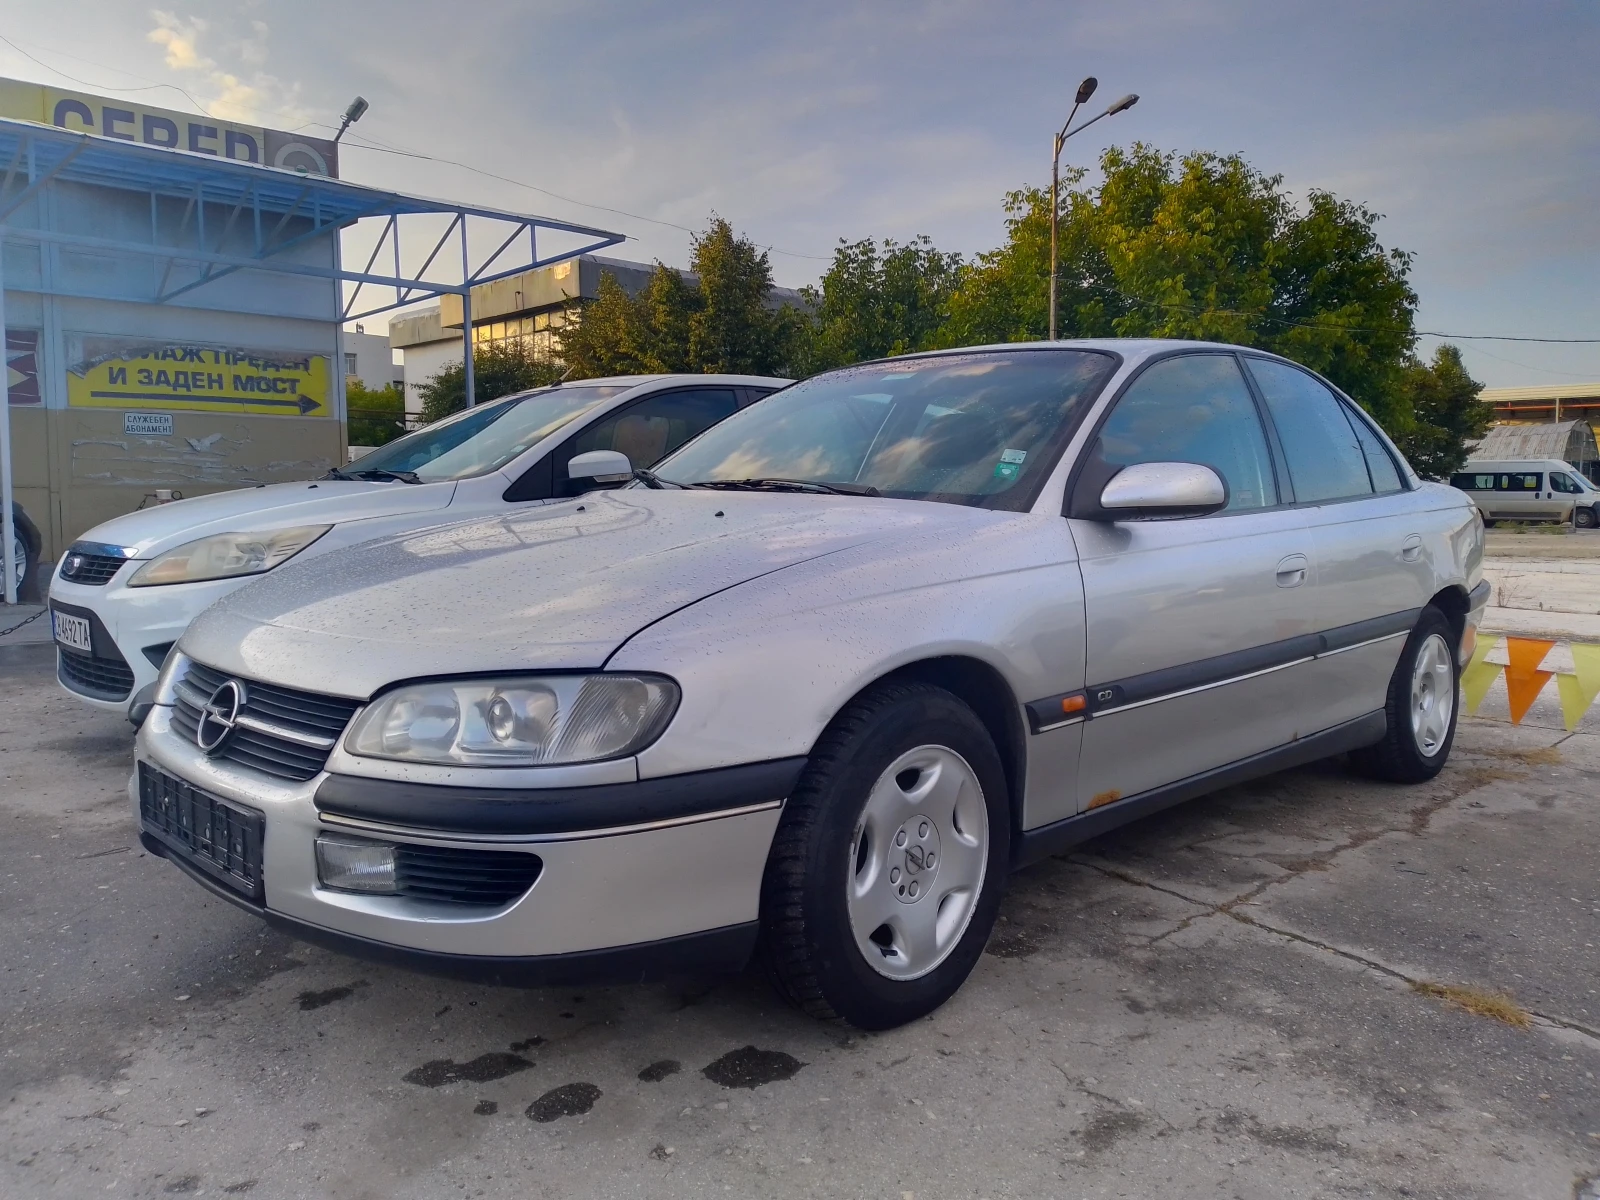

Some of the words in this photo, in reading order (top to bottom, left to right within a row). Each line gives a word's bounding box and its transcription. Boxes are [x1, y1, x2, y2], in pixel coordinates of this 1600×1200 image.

[108, 366, 127, 386] И
[137, 368, 224, 392] ЗАДЕН
[232, 374, 301, 395] МОСТ
[127, 415, 170, 424] СЛУЖЕБЕН
[126, 424, 173, 433] АБОНАМЕНТ
[1098, 690, 1112, 701] CD
